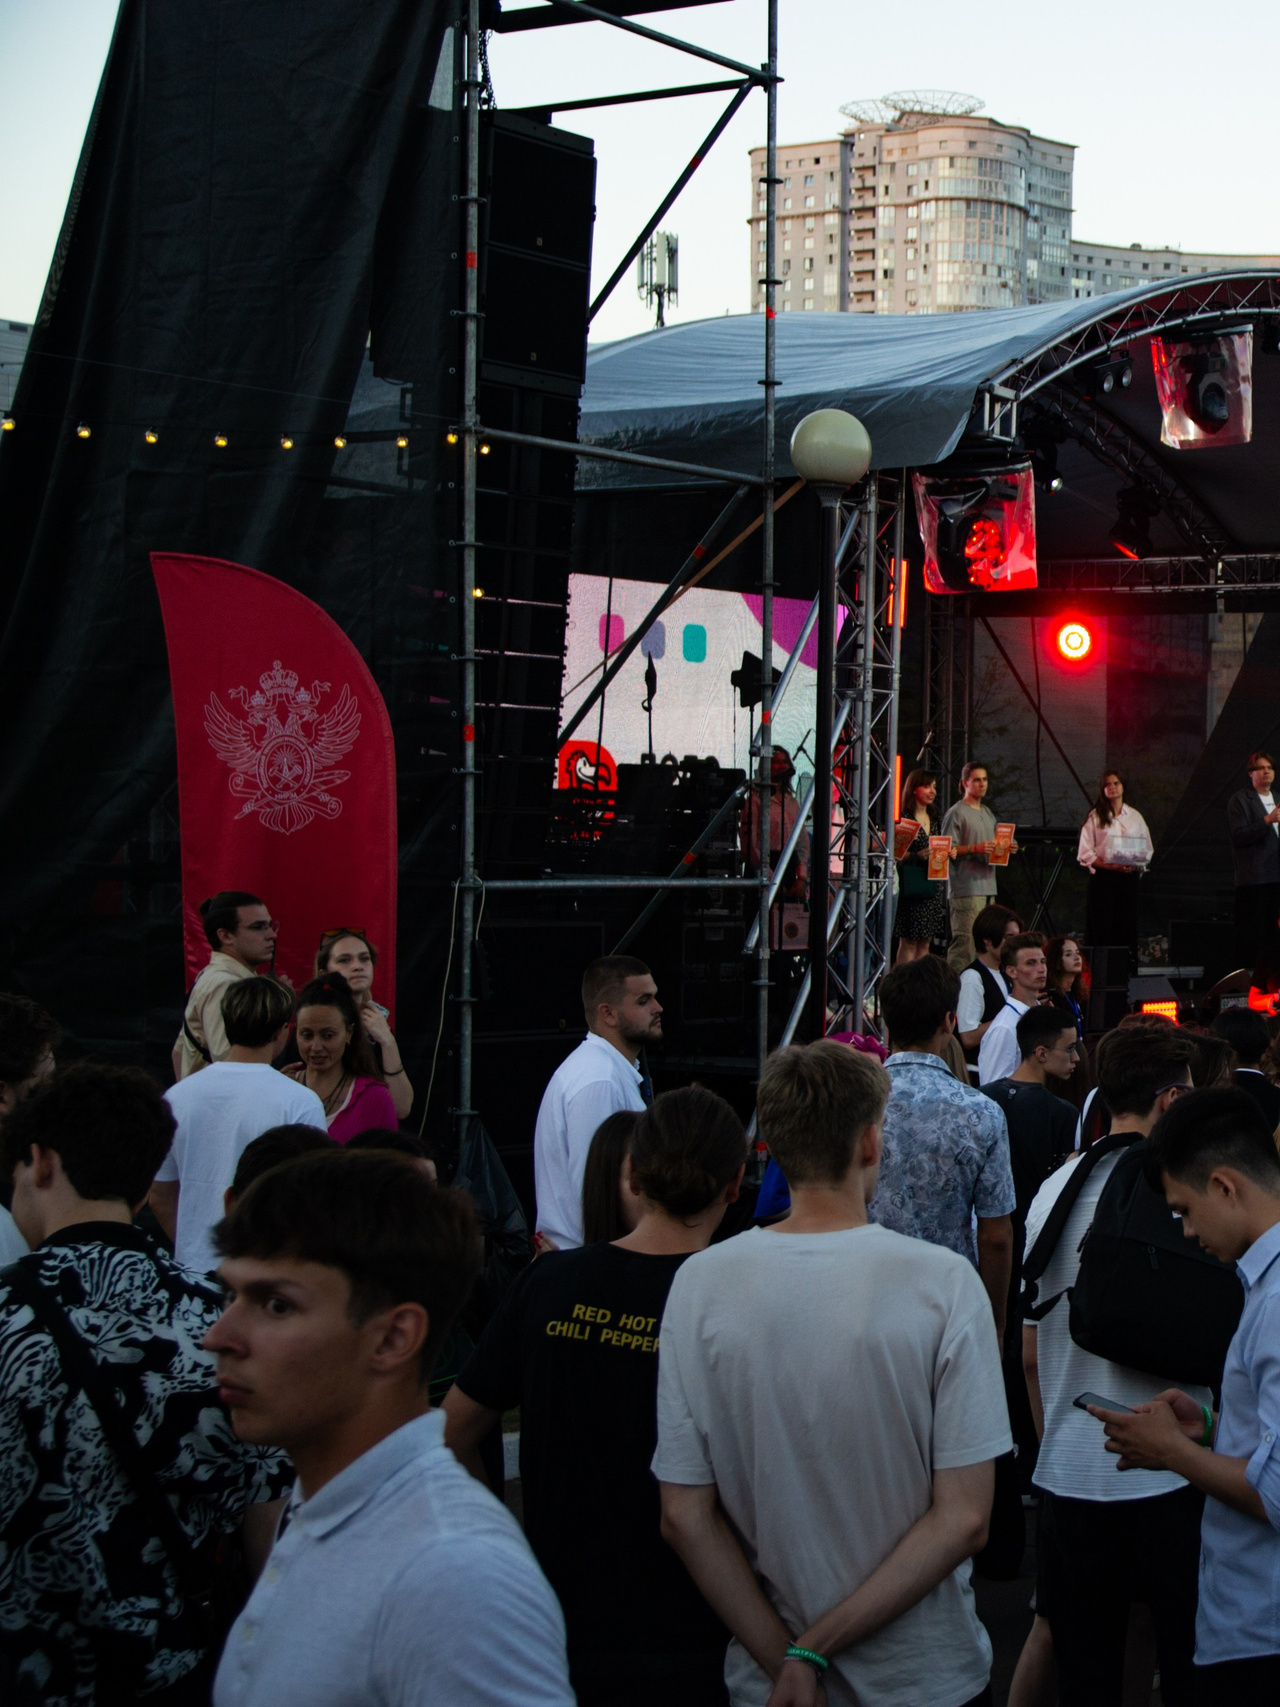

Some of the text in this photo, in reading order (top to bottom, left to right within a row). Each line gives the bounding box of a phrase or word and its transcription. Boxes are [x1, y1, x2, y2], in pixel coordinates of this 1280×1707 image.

[572, 1304, 657, 1332] RED HOT
[546, 1321, 590, 1340] CHILI
